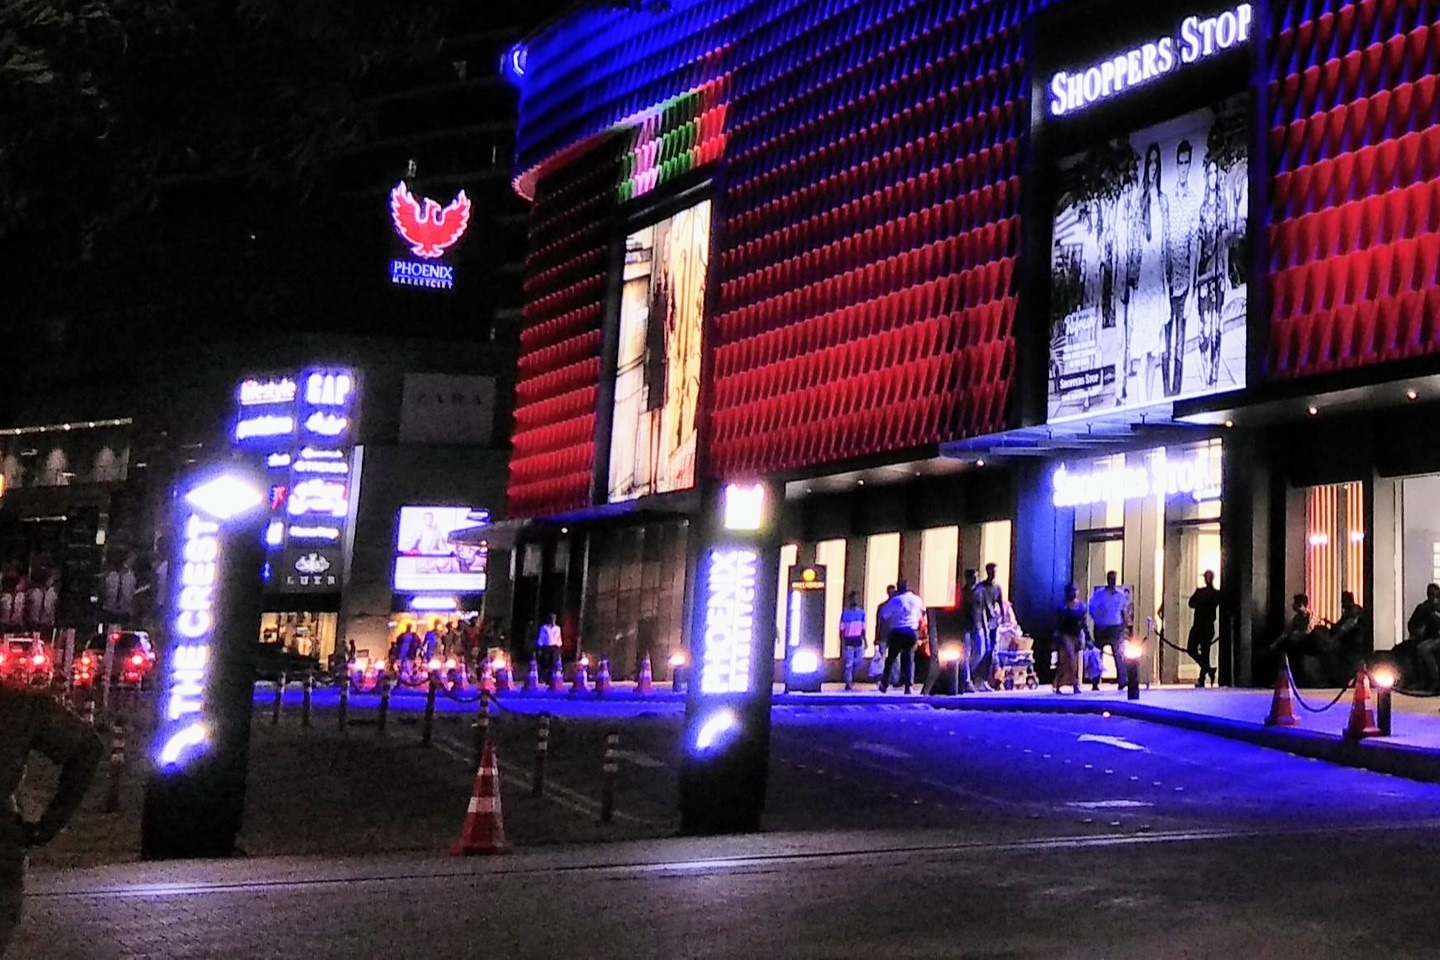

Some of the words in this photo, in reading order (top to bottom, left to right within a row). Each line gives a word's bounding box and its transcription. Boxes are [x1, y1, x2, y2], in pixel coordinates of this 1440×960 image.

[1051, 37, 1173, 116] SHOPPERS
[1181, 3, 1251, 63] STOP
[393, 260, 453, 280] PHOENIX
[307, 373, 350, 405] GAP
[177, 514, 219, 638] CREST
[168, 645, 210, 721] THE
